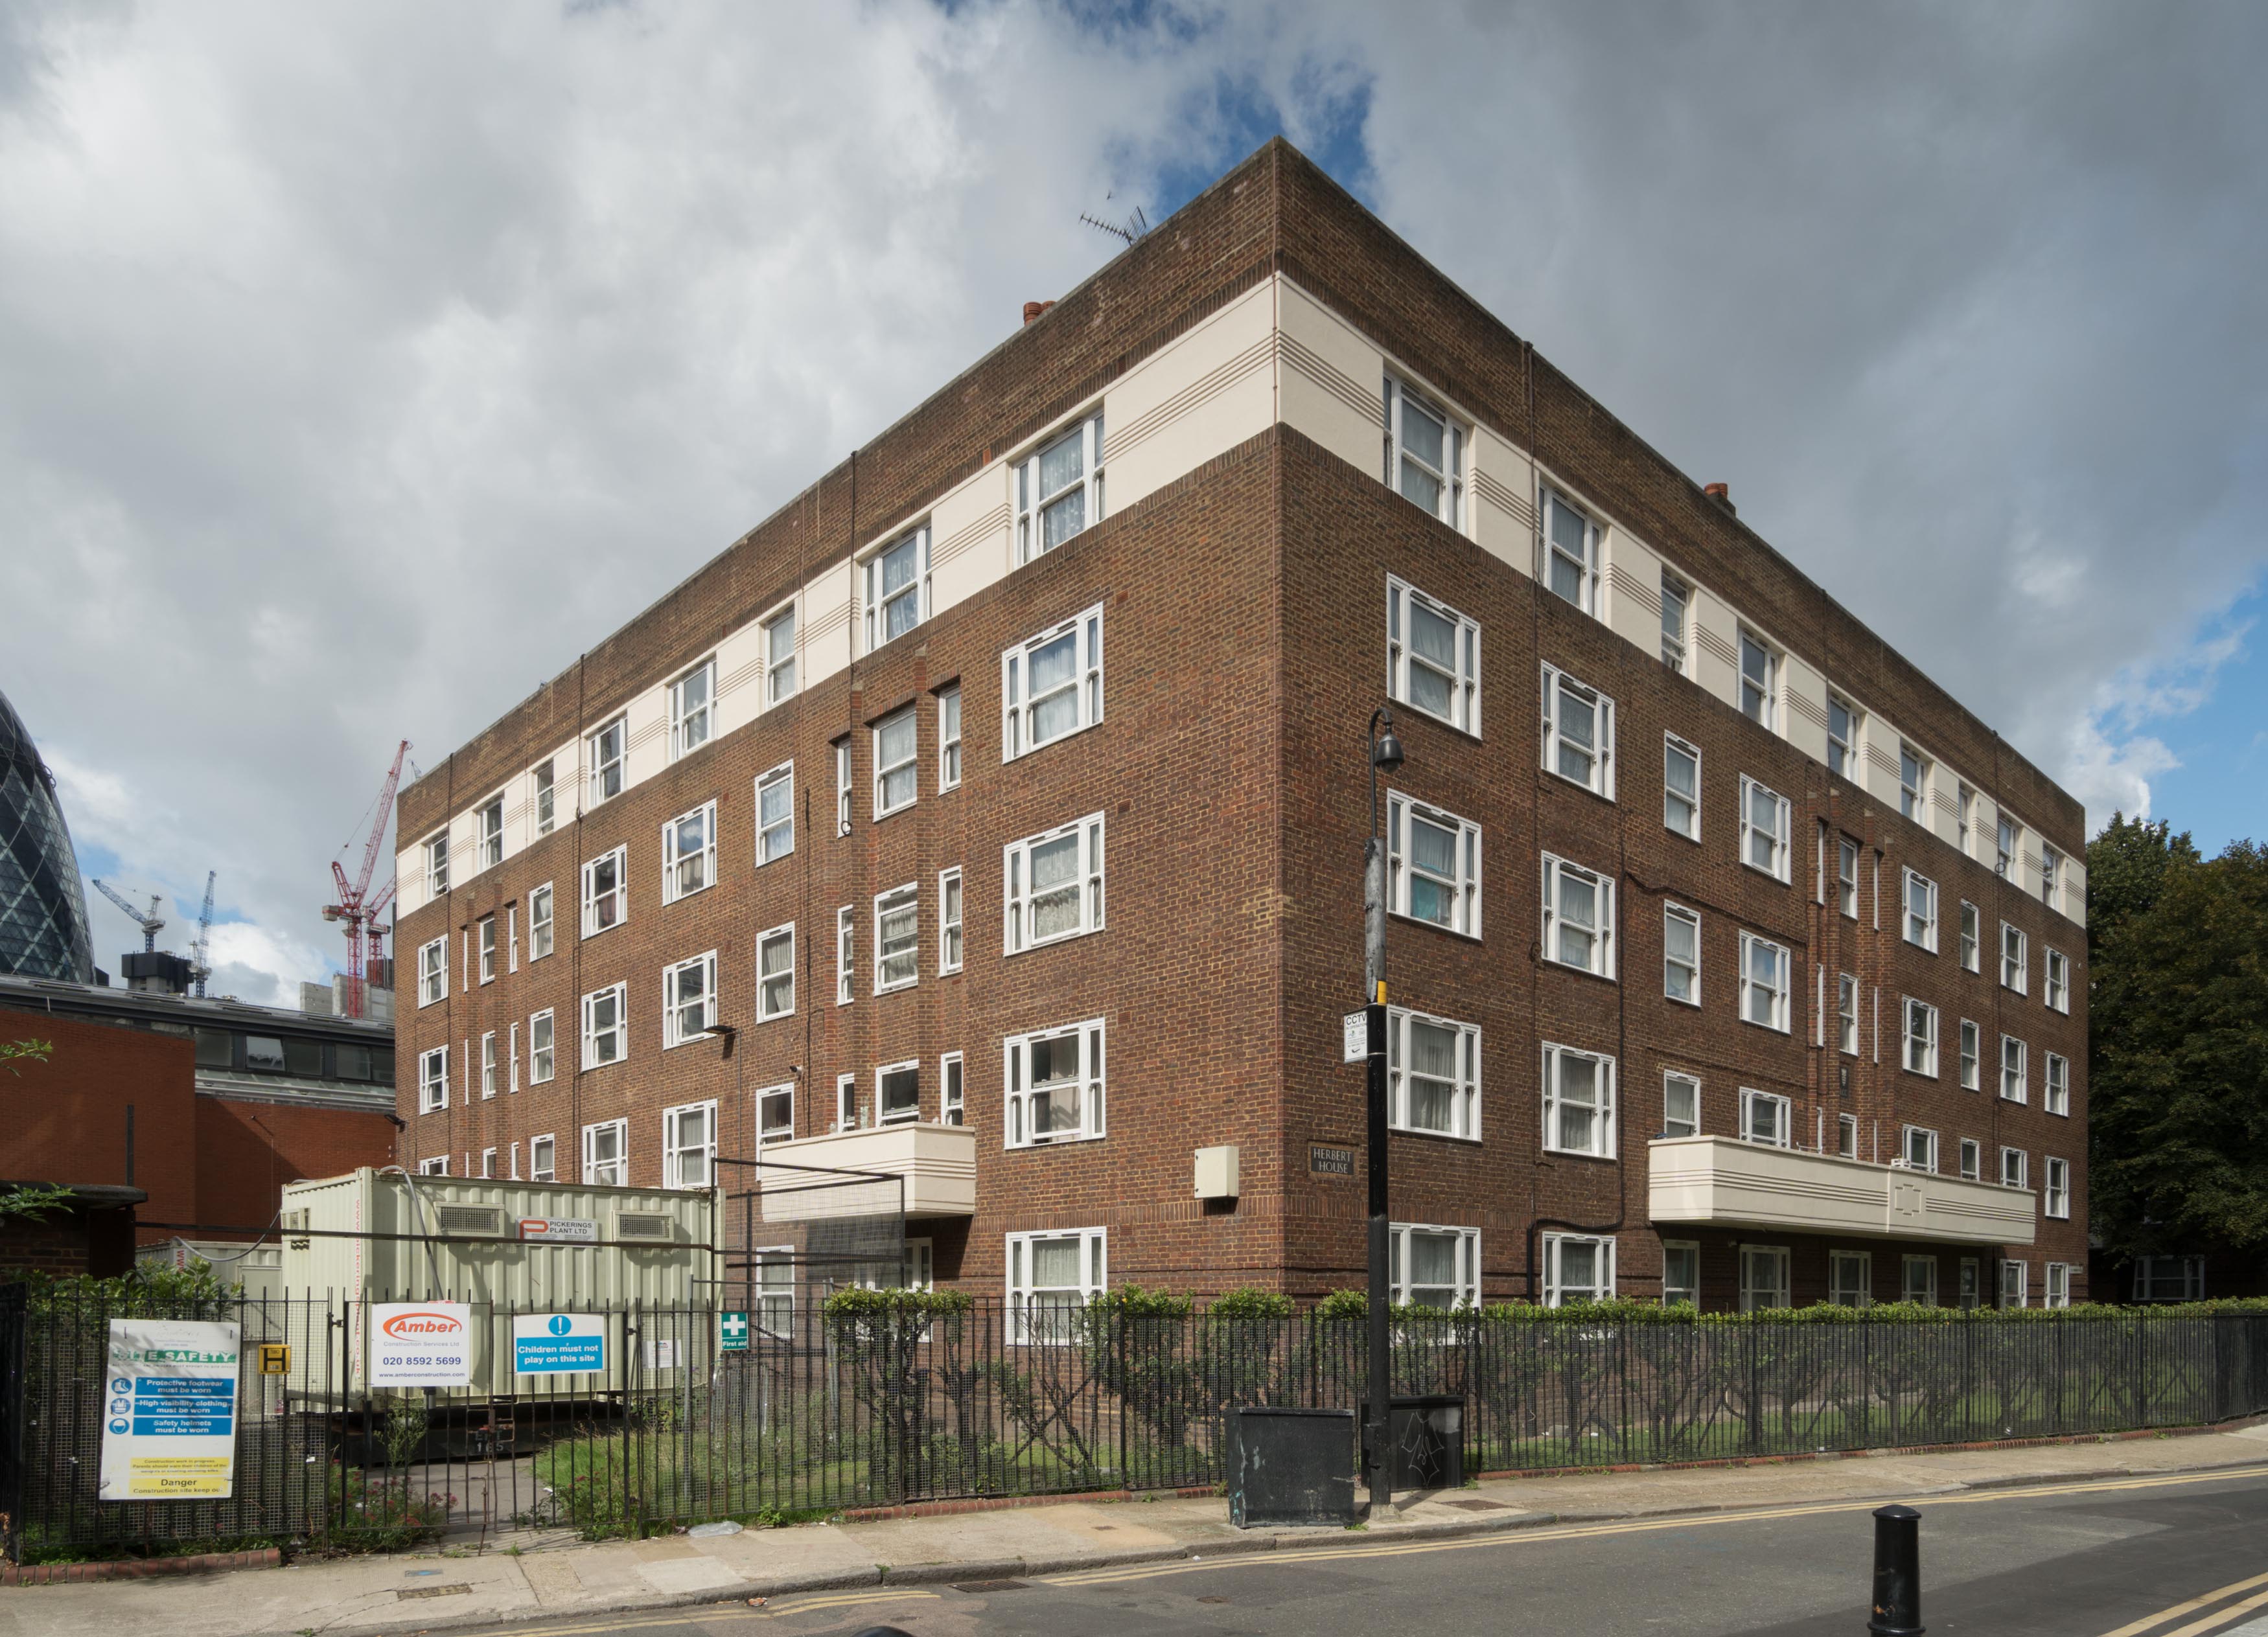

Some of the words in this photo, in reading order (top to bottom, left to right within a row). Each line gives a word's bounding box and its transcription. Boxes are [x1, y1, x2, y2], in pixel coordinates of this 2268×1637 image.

[1347, 1014, 1367, 1025] CCTV
[1313, 1147, 1352, 1162] HERBERT
[1319, 1161, 1348, 1173] HOUSE
[393, 1320, 457, 1333] Amber
[166, 1351, 231, 1362] SAFETY
[524, 1356, 544, 1365] play
